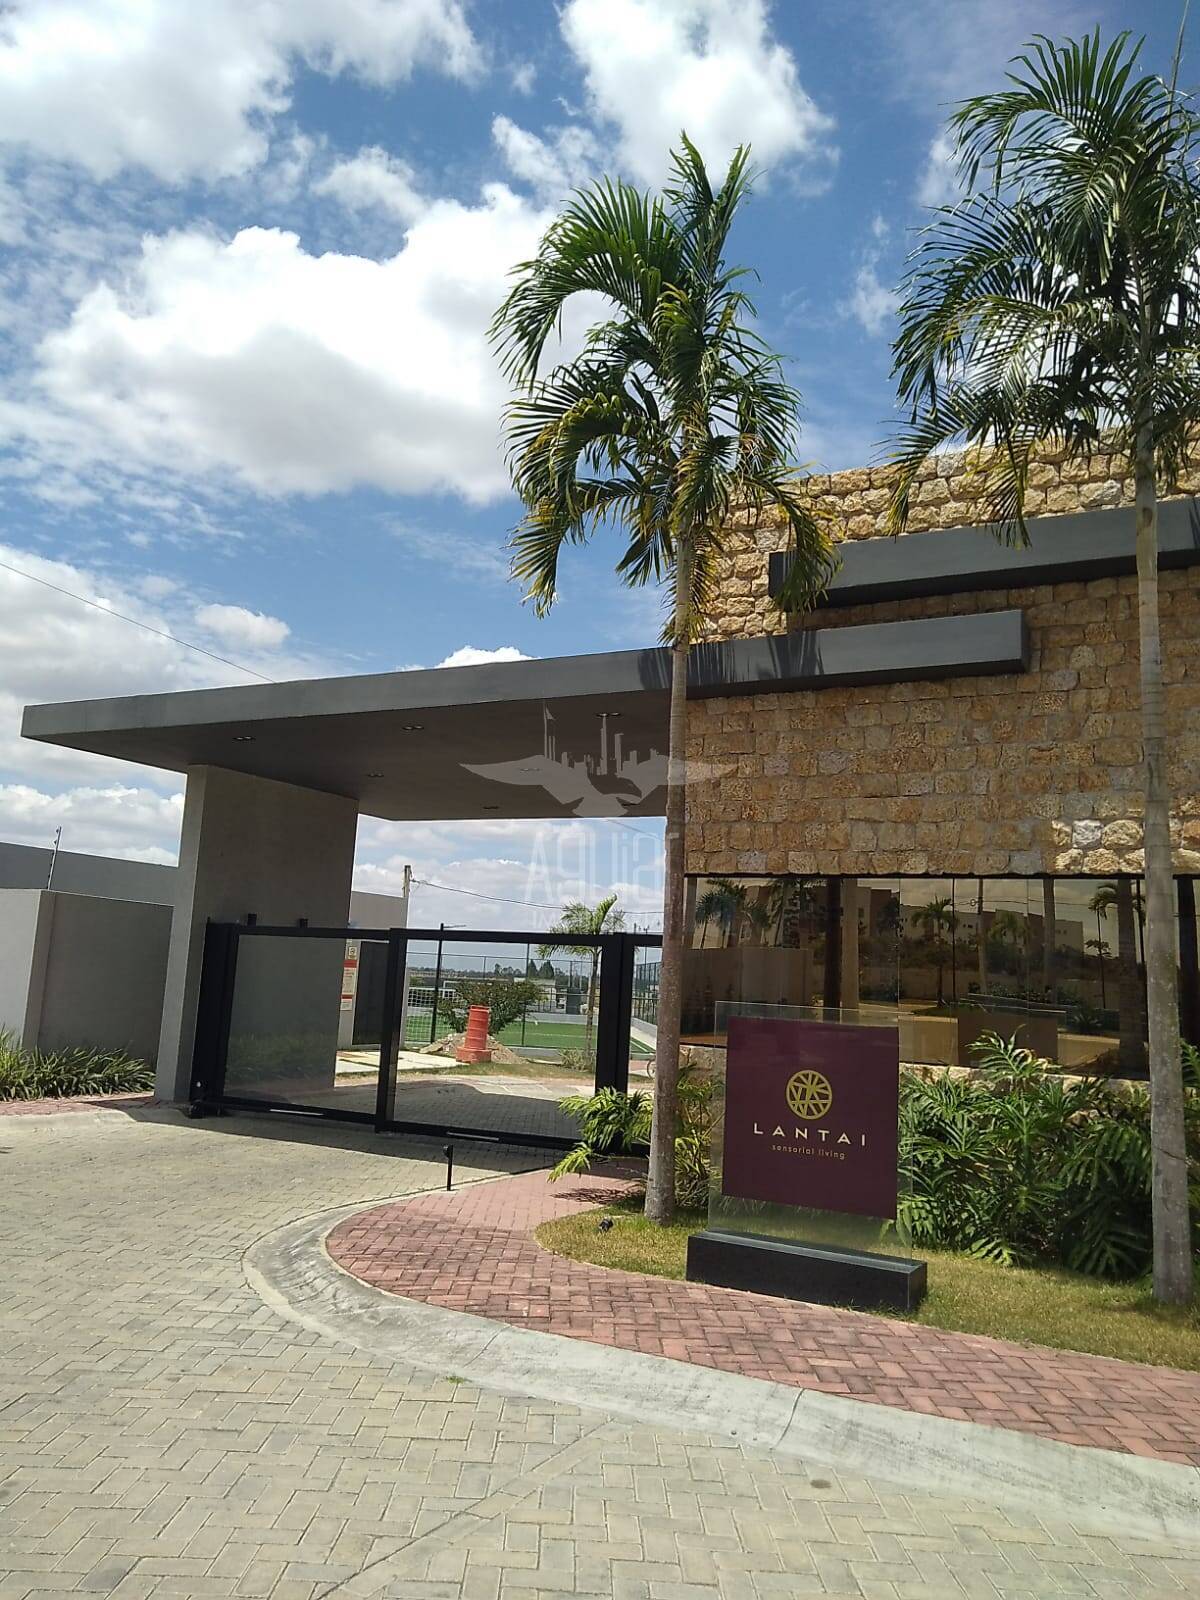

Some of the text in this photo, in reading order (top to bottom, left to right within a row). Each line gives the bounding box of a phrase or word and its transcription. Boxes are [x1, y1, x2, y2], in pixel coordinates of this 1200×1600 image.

[753, 1122, 867, 1146] LANTAI
[771, 1143, 846, 1160] sensorial living
